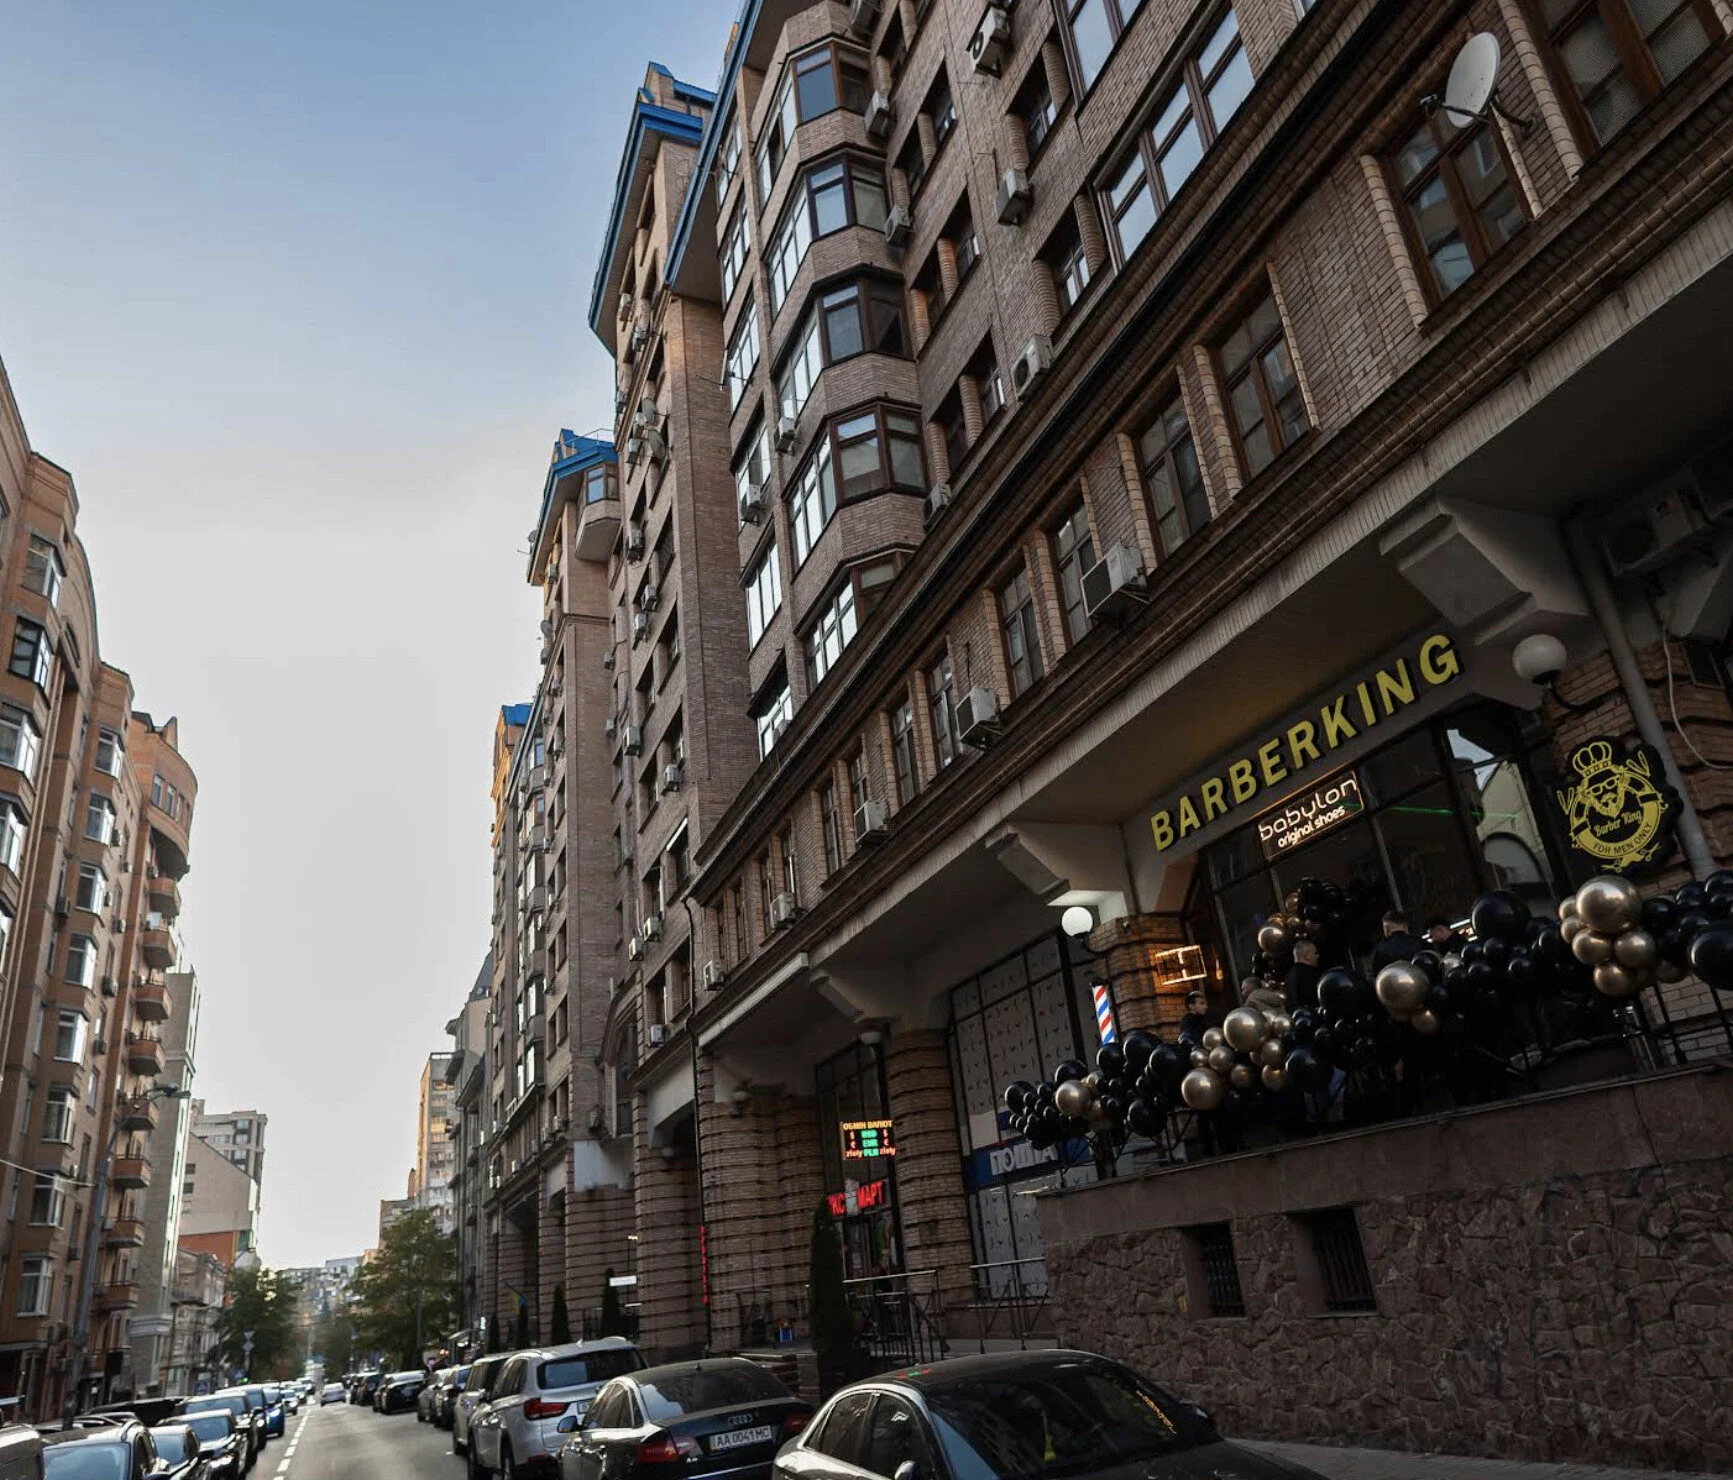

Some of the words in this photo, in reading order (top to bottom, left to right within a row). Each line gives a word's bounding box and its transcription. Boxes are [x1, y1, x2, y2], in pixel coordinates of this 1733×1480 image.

[1151, 634, 1460, 851] BARBERKING
[1258, 779, 1357, 841] babylon
[1277, 820, 1315, 848] original
[1314, 805, 1346, 829] shoes
[1593, 843, 1612, 854] FOR
[1613, 842, 1634, 854] MEN
[1633, 823, 1652, 846] ONLY
